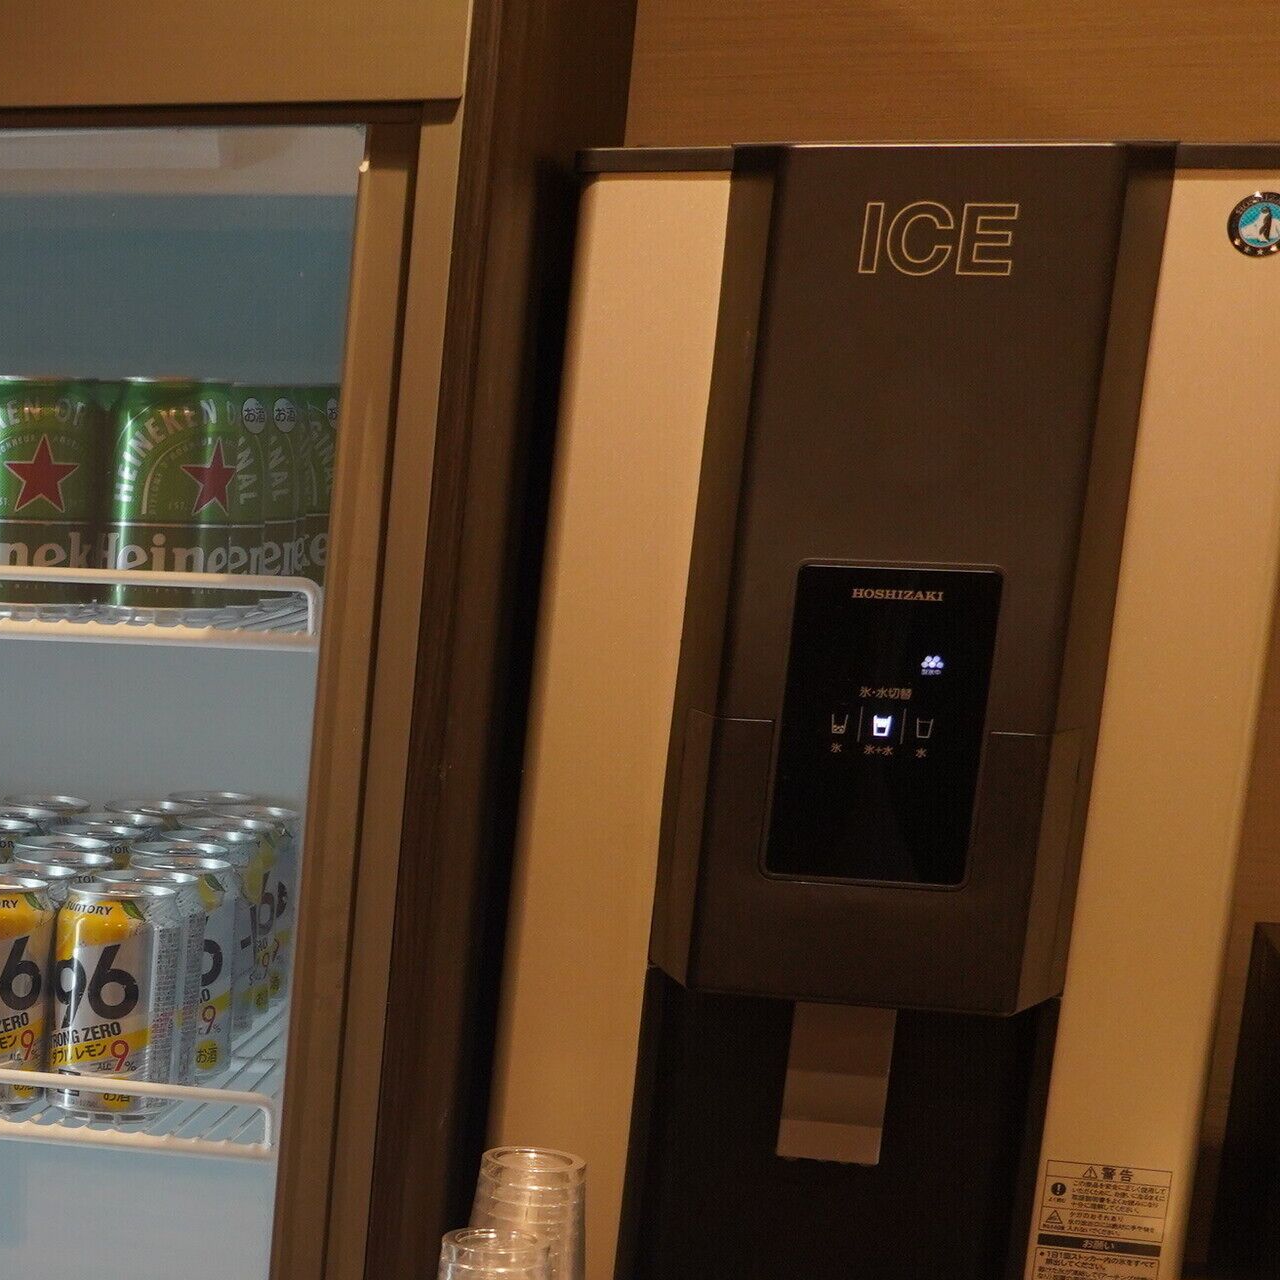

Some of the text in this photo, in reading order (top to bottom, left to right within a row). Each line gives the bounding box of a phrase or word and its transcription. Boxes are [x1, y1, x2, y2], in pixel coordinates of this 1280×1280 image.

[858, 201, 1019, 275] ICE
[852, 588, 944, 601] HOSHIZAKI
[65, 902, 113, 915] SUNTORY
[82, 1022, 122, 1041] ZERO
[1101, 1167, 1133, 1182] 警告
